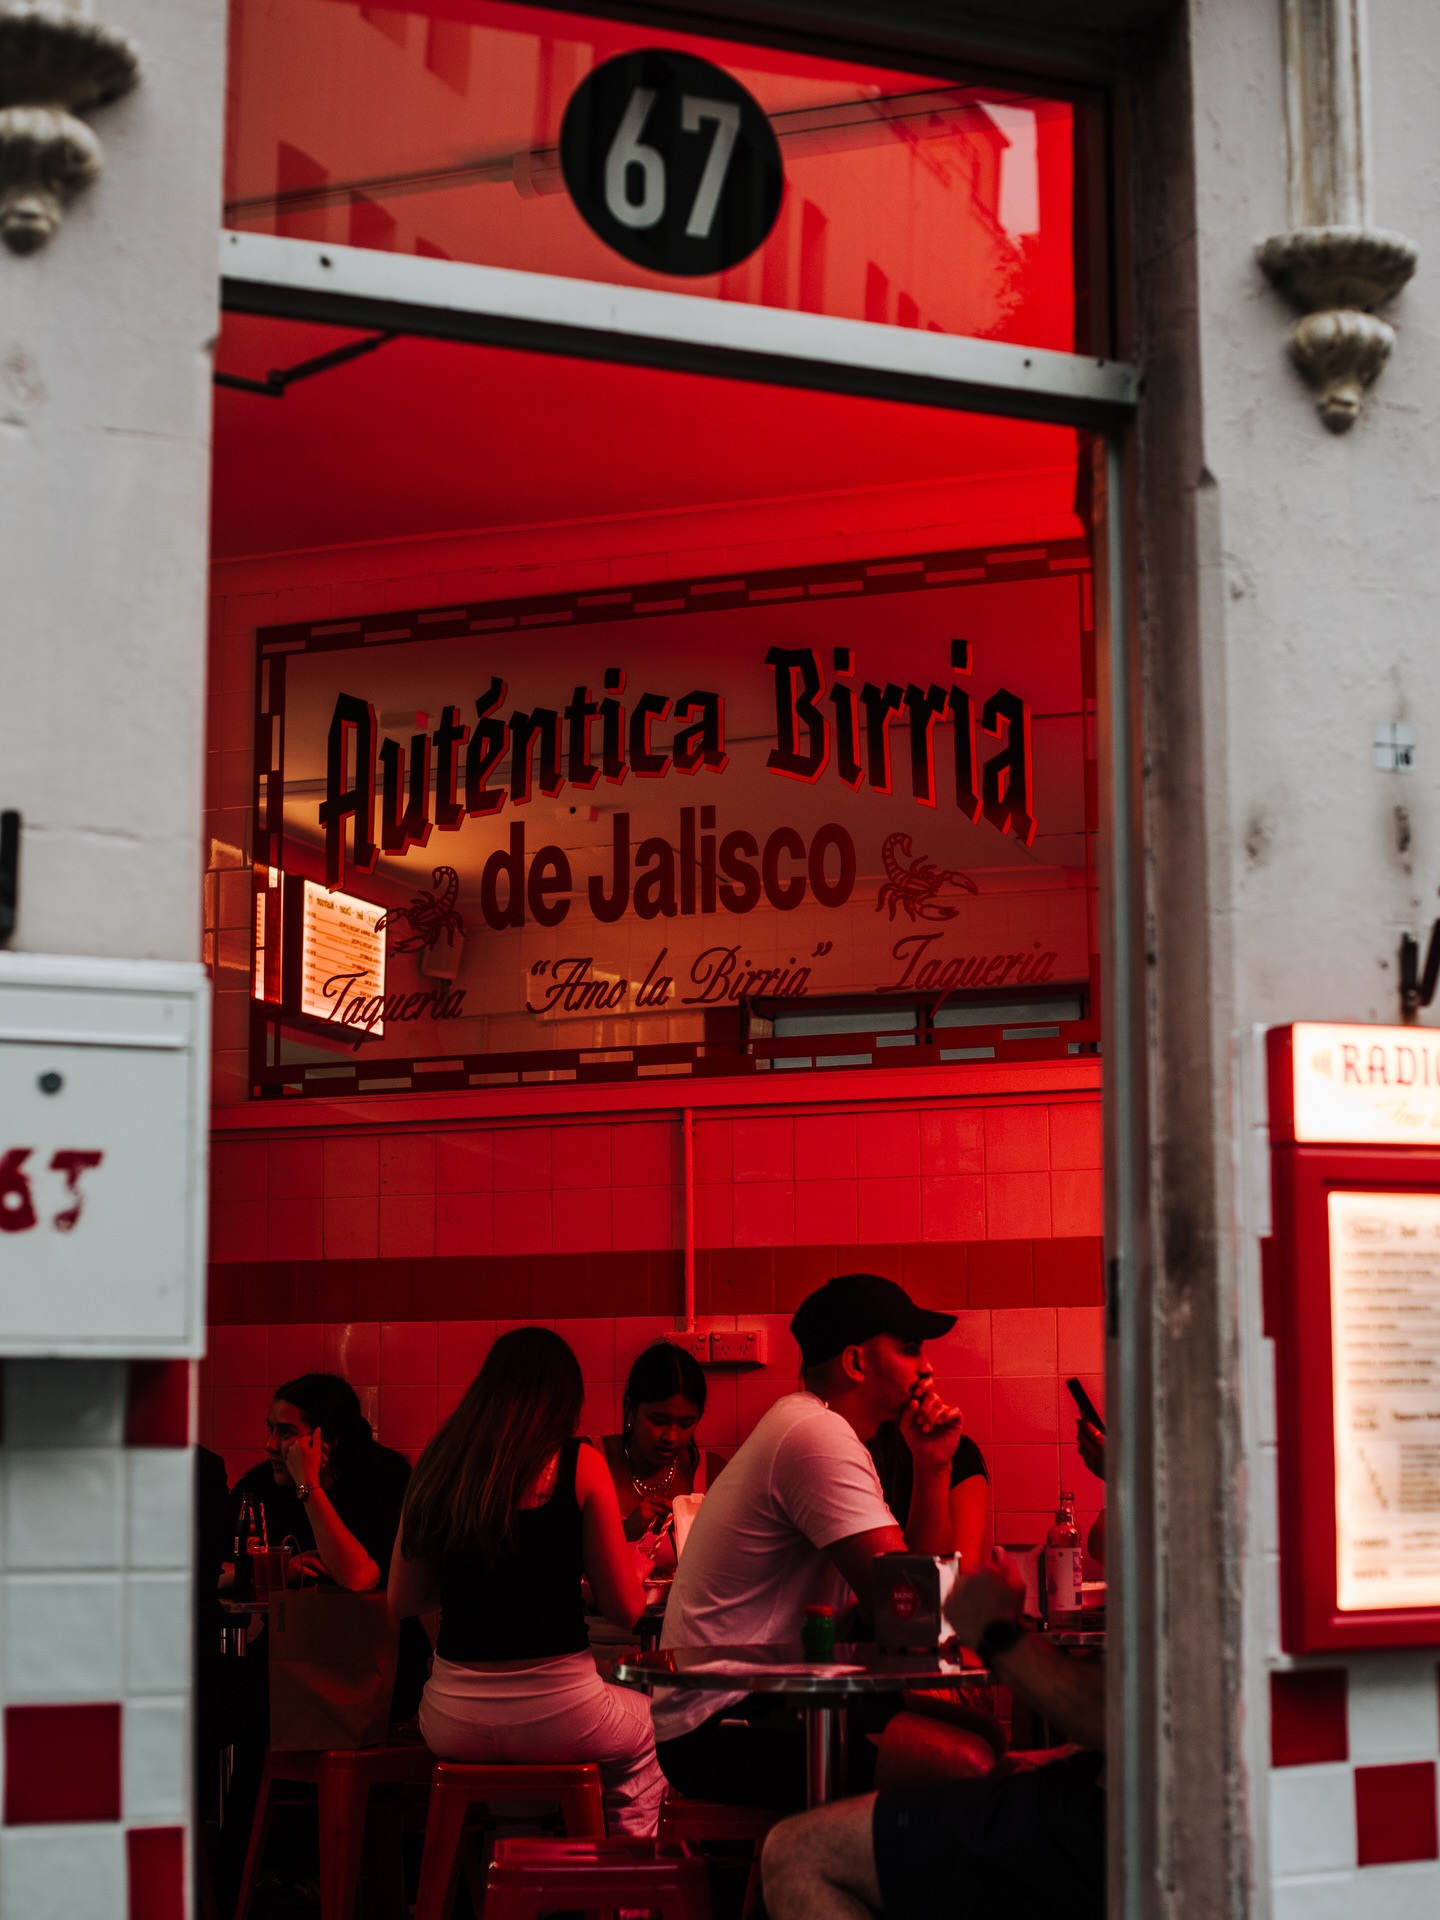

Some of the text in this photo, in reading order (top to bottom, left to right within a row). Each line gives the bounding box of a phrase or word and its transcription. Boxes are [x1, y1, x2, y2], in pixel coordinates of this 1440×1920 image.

[605, 86, 740, 238] 67
[319, 638, 1038, 893] Auténtica Birria
[481, 805, 857, 931] de Jalisco
[309, 970, 467, 1052] Taqueria
[635, 947, 673, 1008] la
[875, 931, 1058, 1020] Taqueria
[1341, 1043, 1440, 1086] RADI
